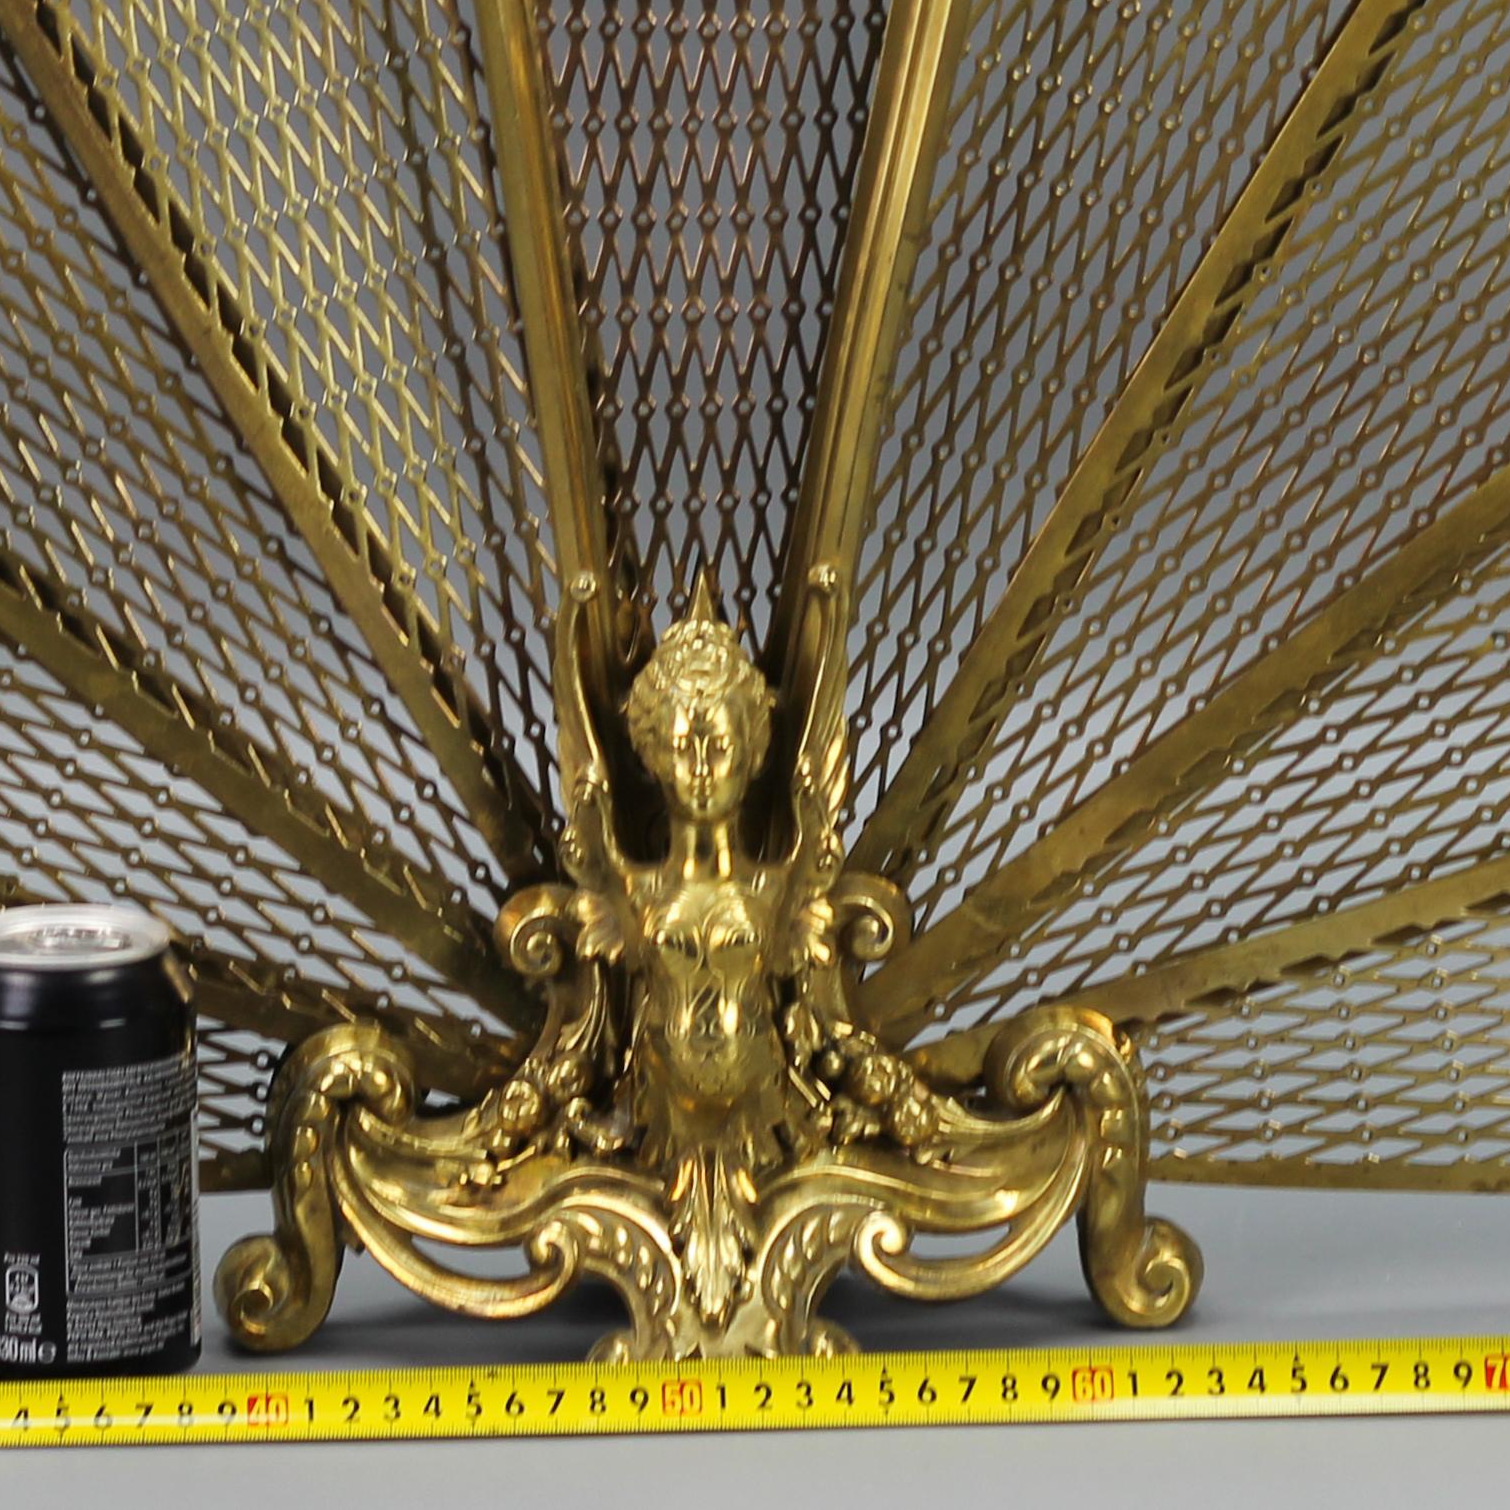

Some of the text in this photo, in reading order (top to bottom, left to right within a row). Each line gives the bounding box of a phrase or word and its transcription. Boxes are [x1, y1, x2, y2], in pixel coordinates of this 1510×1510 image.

[12, 1408, 31, 1434] 4
[54, 1405, 70, 1431] 5
[94, 1405, 111, 1431] 6
[135, 1404, 153, 1429] 7
[178, 1402, 193, 1427] 8
[218, 1401, 237, 1425] 9
[248, 1395, 287, 1427] 40
[305, 1399, 314, 1422] 1
[342, 1396, 360, 1423] 2
[384, 1395, 401, 1421] 3
[424, 1394, 441, 1418] 4
[467, 1393, 482, 1419] 5
[505, 1392, 524, 1415] 6
[548, 1390, 565, 1415] 7
[590, 1388, 606, 1413] 8
[630, 1387, 649, 1413] 9
[663, 1382, 701, 1412] 50
[717, 1385, 726, 1410] 1
[754, 1382, 772, 1409] 2
[797, 1381, 813, 1408] 3
[836, 1381, 854, 1406] 4
[880, 1379, 895, 1405] 5
[918, 1378, 937, 1403] 6
[959, 1377, 976, 1402] 7
[1002, 1375, 1018, 1401] 8
[1041, 1374, 1060, 1400] 9
[1073, 1369, 1113, 1400] 60
[1128, 1371, 1138, 1396] 1
[1166, 1369, 1183, 1396] 2
[1208, 1367, 1225, 1395] 3
[1248, 1368, 1266, 1393] 4
[1292, 1367, 1307, 1393] 5
[1330, 1365, 1349, 1392] 6
[1371, 1364, 1388, 1390] 7
[1414, 1362, 1430, 1389] 8
[1454, 1361, 1472, 1389] 9
